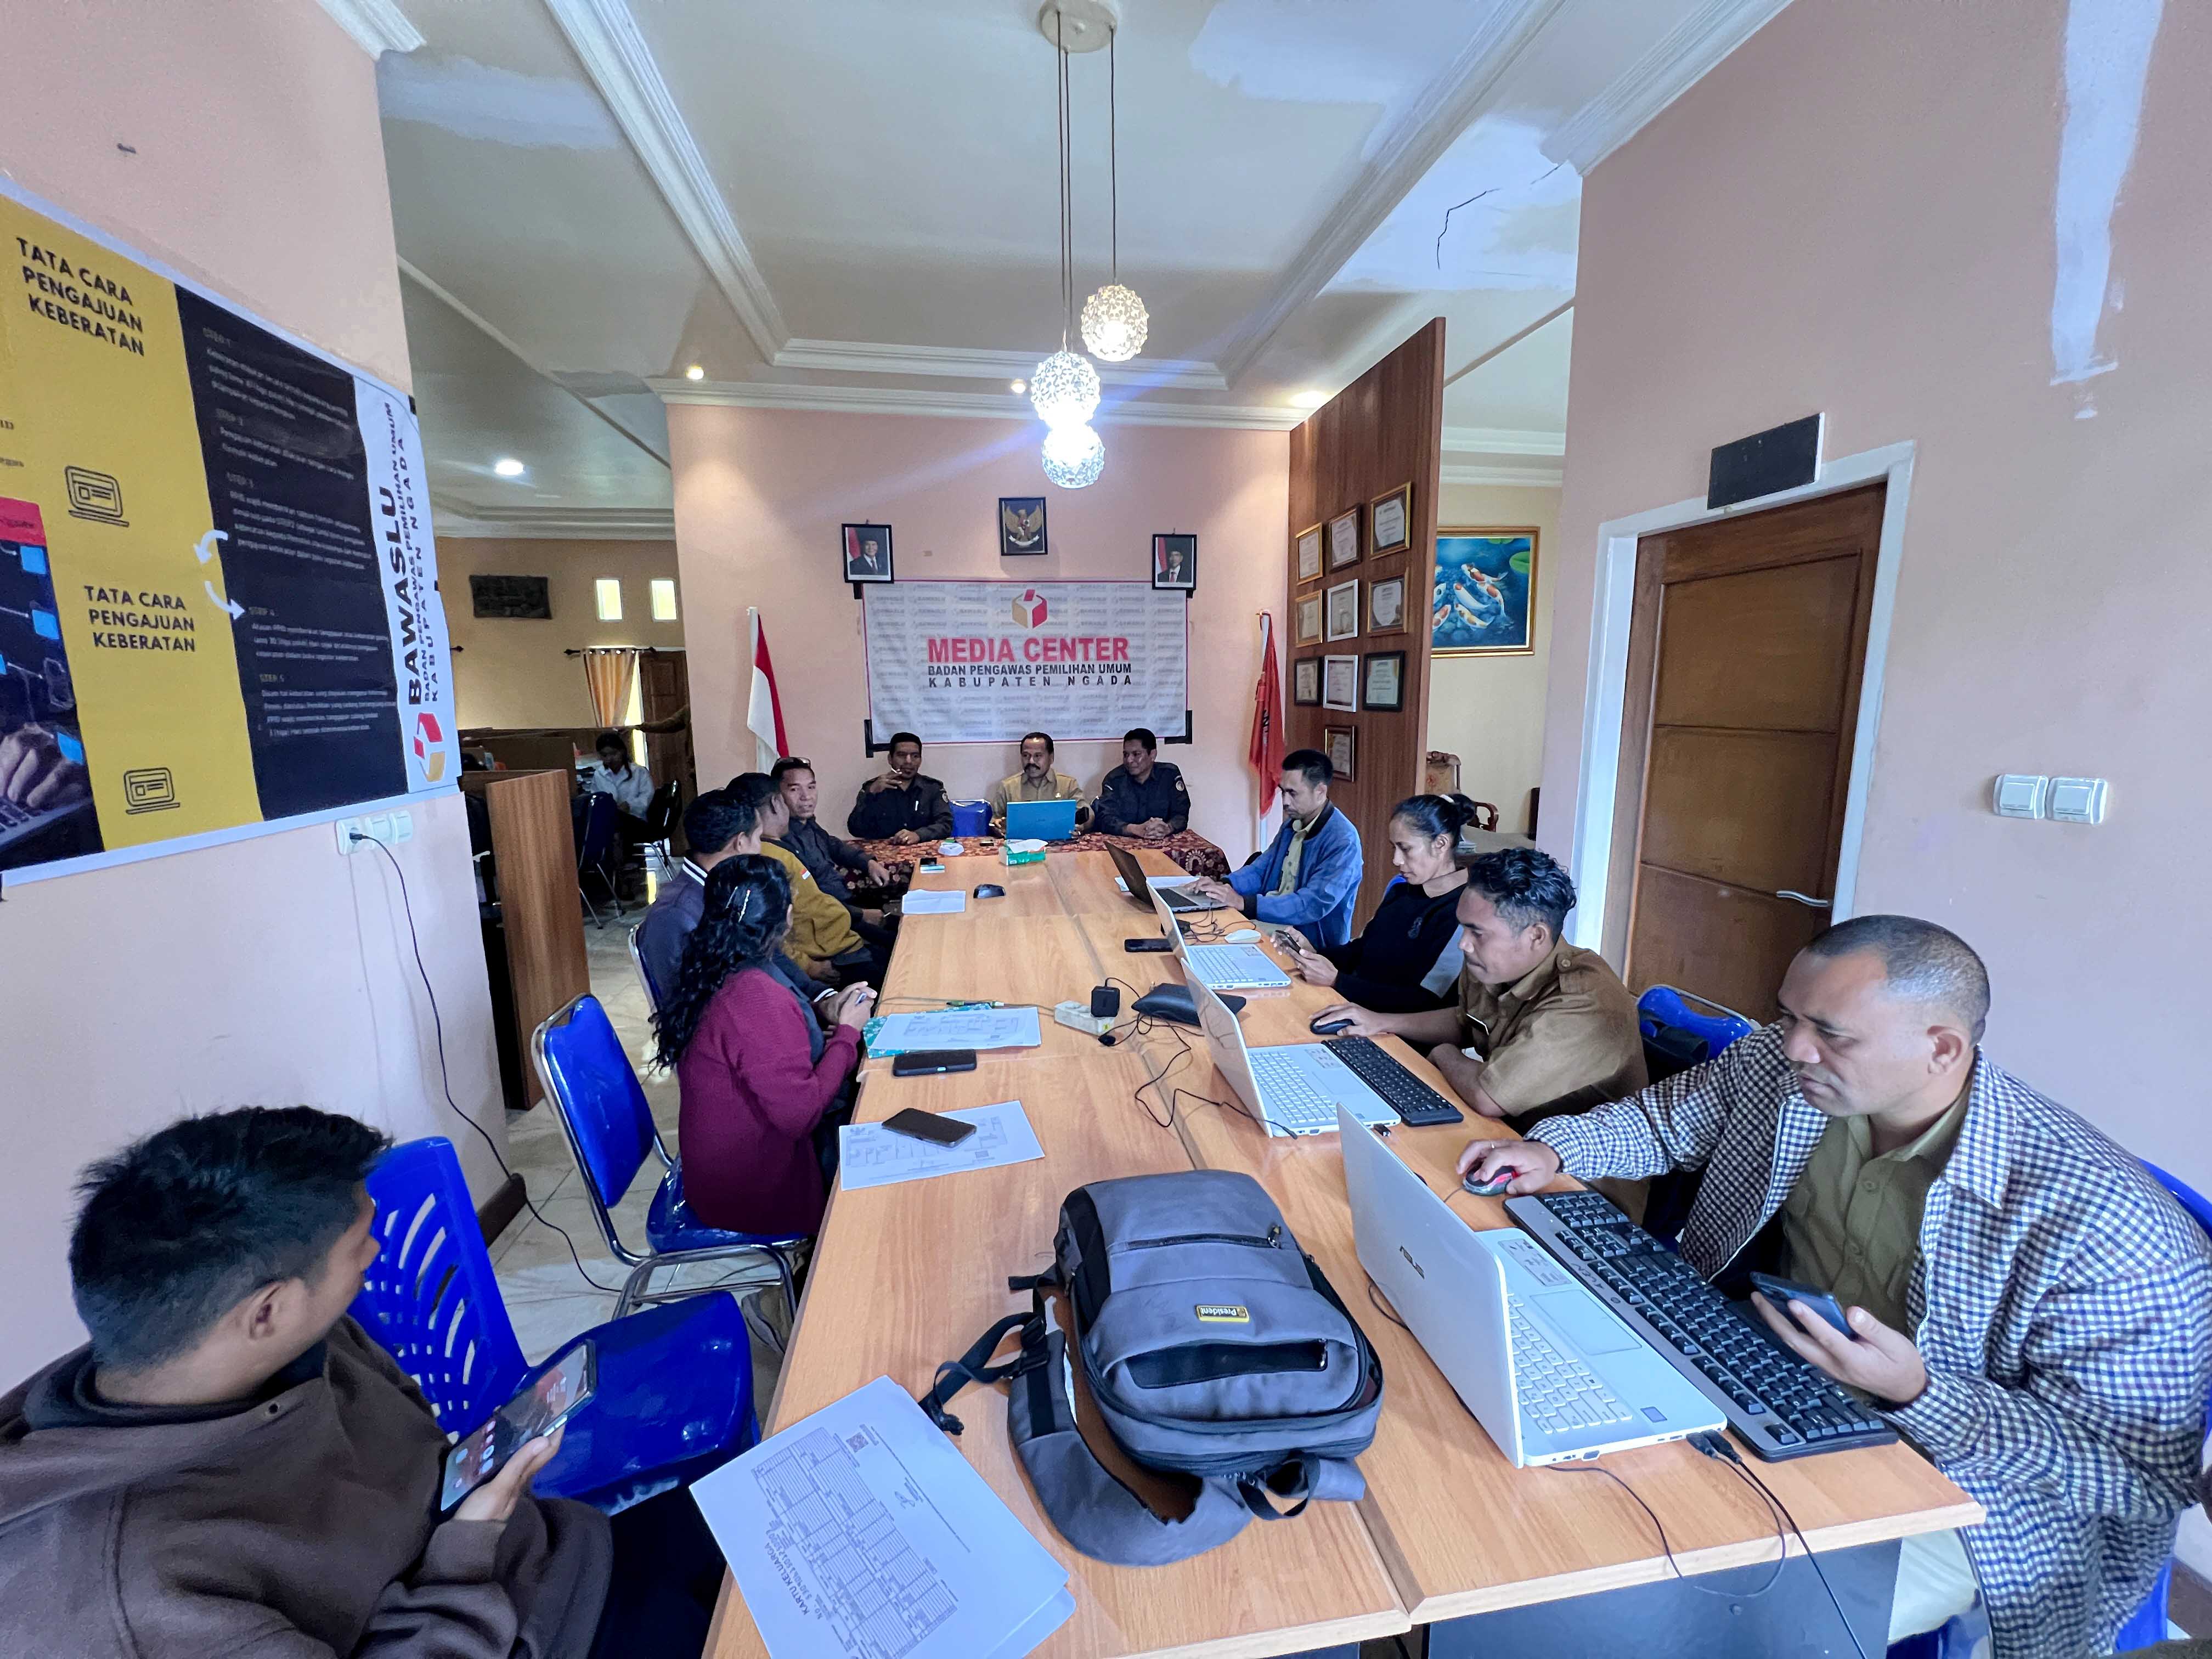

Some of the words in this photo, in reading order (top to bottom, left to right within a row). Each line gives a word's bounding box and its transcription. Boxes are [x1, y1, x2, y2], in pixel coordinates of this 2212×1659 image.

[16, 238, 74, 278] TATA
[79, 267, 133, 306] CARA
[22, 266, 144, 333] PENGAJUAN
[28, 294, 144, 357] KEBERATAN
[384, 402, 398, 455] UMUM
[392, 460, 413, 551] PEMILIHAN
[397, 438, 419, 530] NGADA
[84, 585, 133, 606] TATA
[139, 591, 185, 610] CARA
[89, 610, 195, 632] PENGAJUAN
[377, 487, 422, 705] BAWASLU
[408, 556, 426, 644] PENGAWAS
[93, 633, 195, 652] KEBERATAN
[415, 547, 438, 702] KABUPATEN
[928, 637, 1015, 663] MEDIA
[1024, 637, 1129, 662] CENTER
[420, 650, 430, 702] BADAN
[928, 665, 966, 675] BADAN
[970, 664, 1032, 675] PENGAWAS
[1036, 663, 1095, 675] PEMILIHAN
[1099, 663, 1132, 674] UMUM
[929, 676, 1051, 687] KABUPATEN
[1068, 675, 1132, 686] NGADA
[1200, 1307, 1237, 1316] President
[764, 1543, 793, 1587] KELUARGA
[789, 1585, 810, 1616] KARTU
